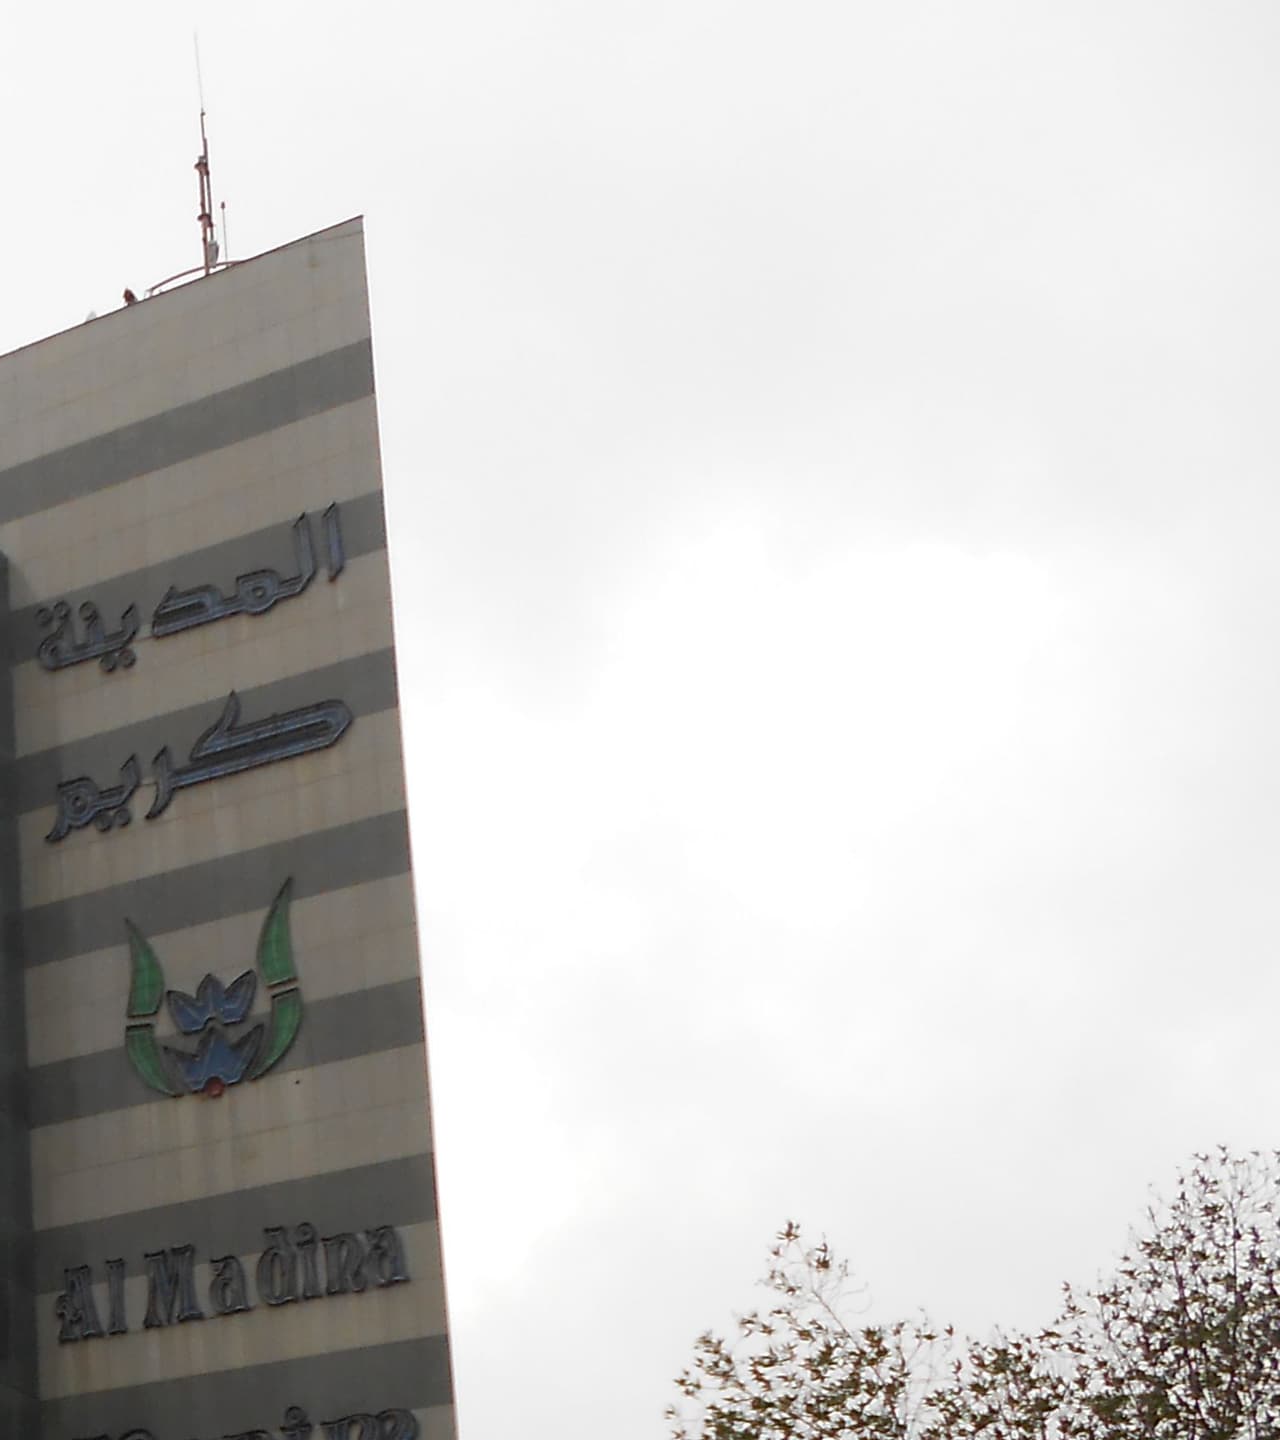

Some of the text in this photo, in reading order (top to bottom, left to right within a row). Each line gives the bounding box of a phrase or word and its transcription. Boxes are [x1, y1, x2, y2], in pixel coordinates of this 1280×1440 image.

[35, 502, 345, 672] المدينة
[45, 690, 353, 844] كريم
[56, 1221, 411, 1344] Al Madina
